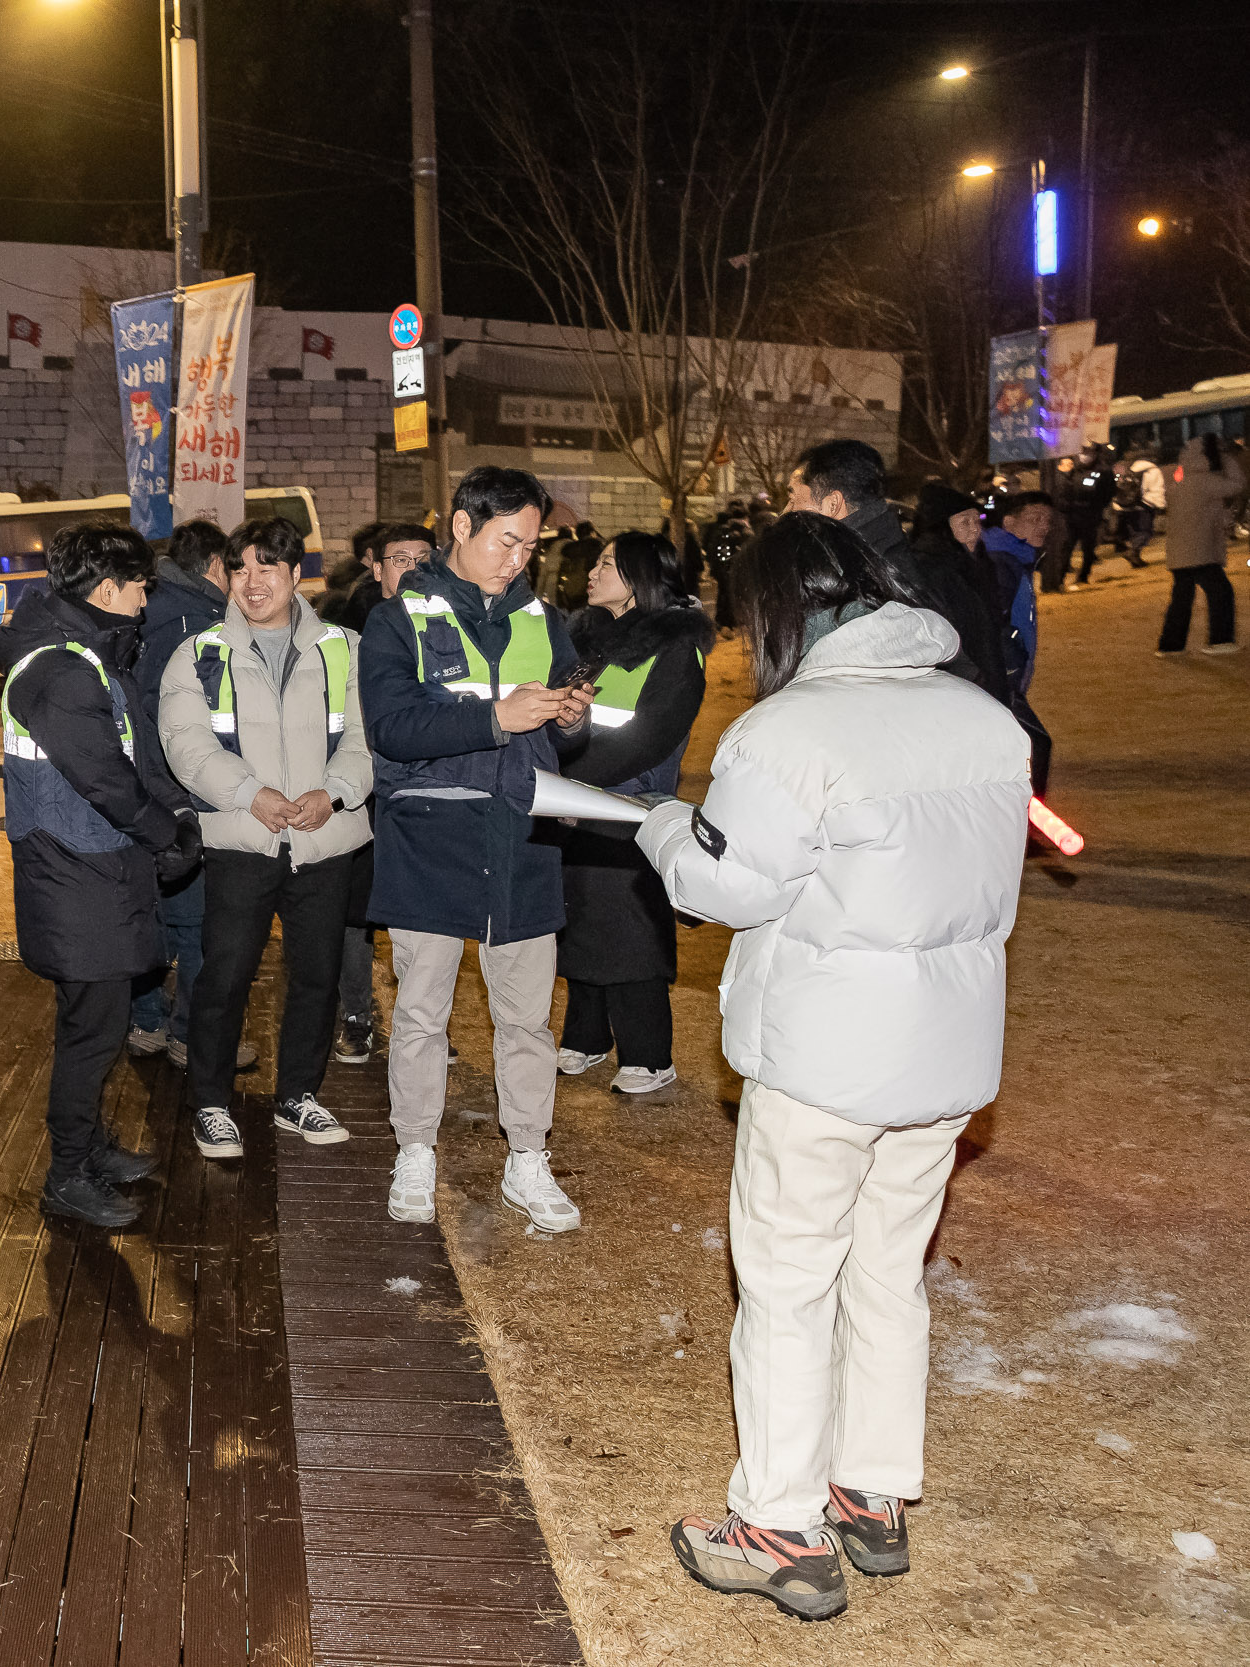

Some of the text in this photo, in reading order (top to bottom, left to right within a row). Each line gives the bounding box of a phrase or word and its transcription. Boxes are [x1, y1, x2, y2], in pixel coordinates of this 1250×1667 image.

[118, 319, 168, 351] 2024
[184, 392, 238, 423] 가득한
[178, 424, 240, 459] 새해
[181, 461, 238, 485] 되세요
